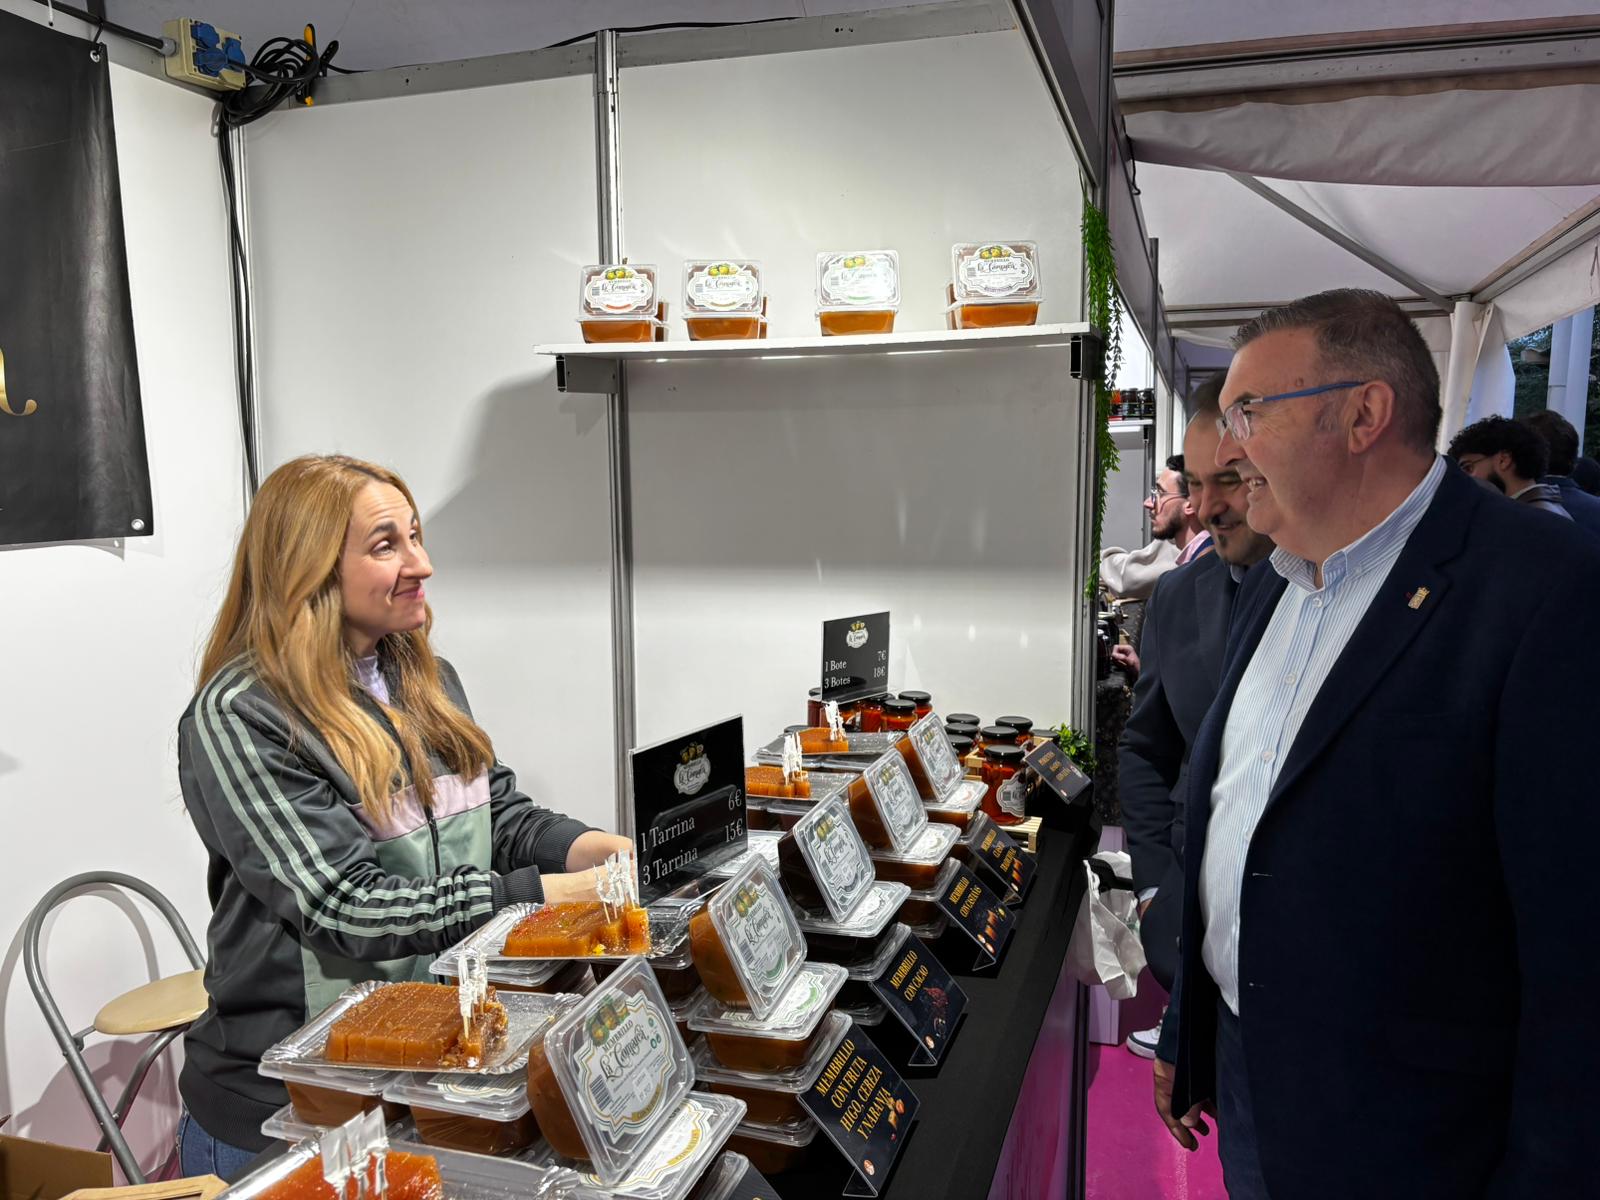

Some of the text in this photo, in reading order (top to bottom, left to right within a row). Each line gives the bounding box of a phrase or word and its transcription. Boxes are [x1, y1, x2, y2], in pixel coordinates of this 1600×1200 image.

[824, 666, 886, 689] 3 Botes 18€
[830, 660, 847, 671] Bote
[877, 650, 887, 661] 7€
[640, 788, 742, 853] 1 Tarrina 6€
[642, 818, 744, 886] 3 Tarrina 15€
[889, 949, 919, 990] MEMBRILLO
[903, 965, 929, 1002] CON CACAO
[599, 1054, 622, 1083] La
[613, 1024, 650, 1070] Comarca
[601, 1019, 634, 1052] MEMBRILLO
[814, 1038, 856, 1097] MEMBRILLO
[830, 1055, 868, 1109] CON FRUTA
[839, 1065, 883, 1133] HIGO, CEREZA
[856, 1127, 869, 1141] Y
